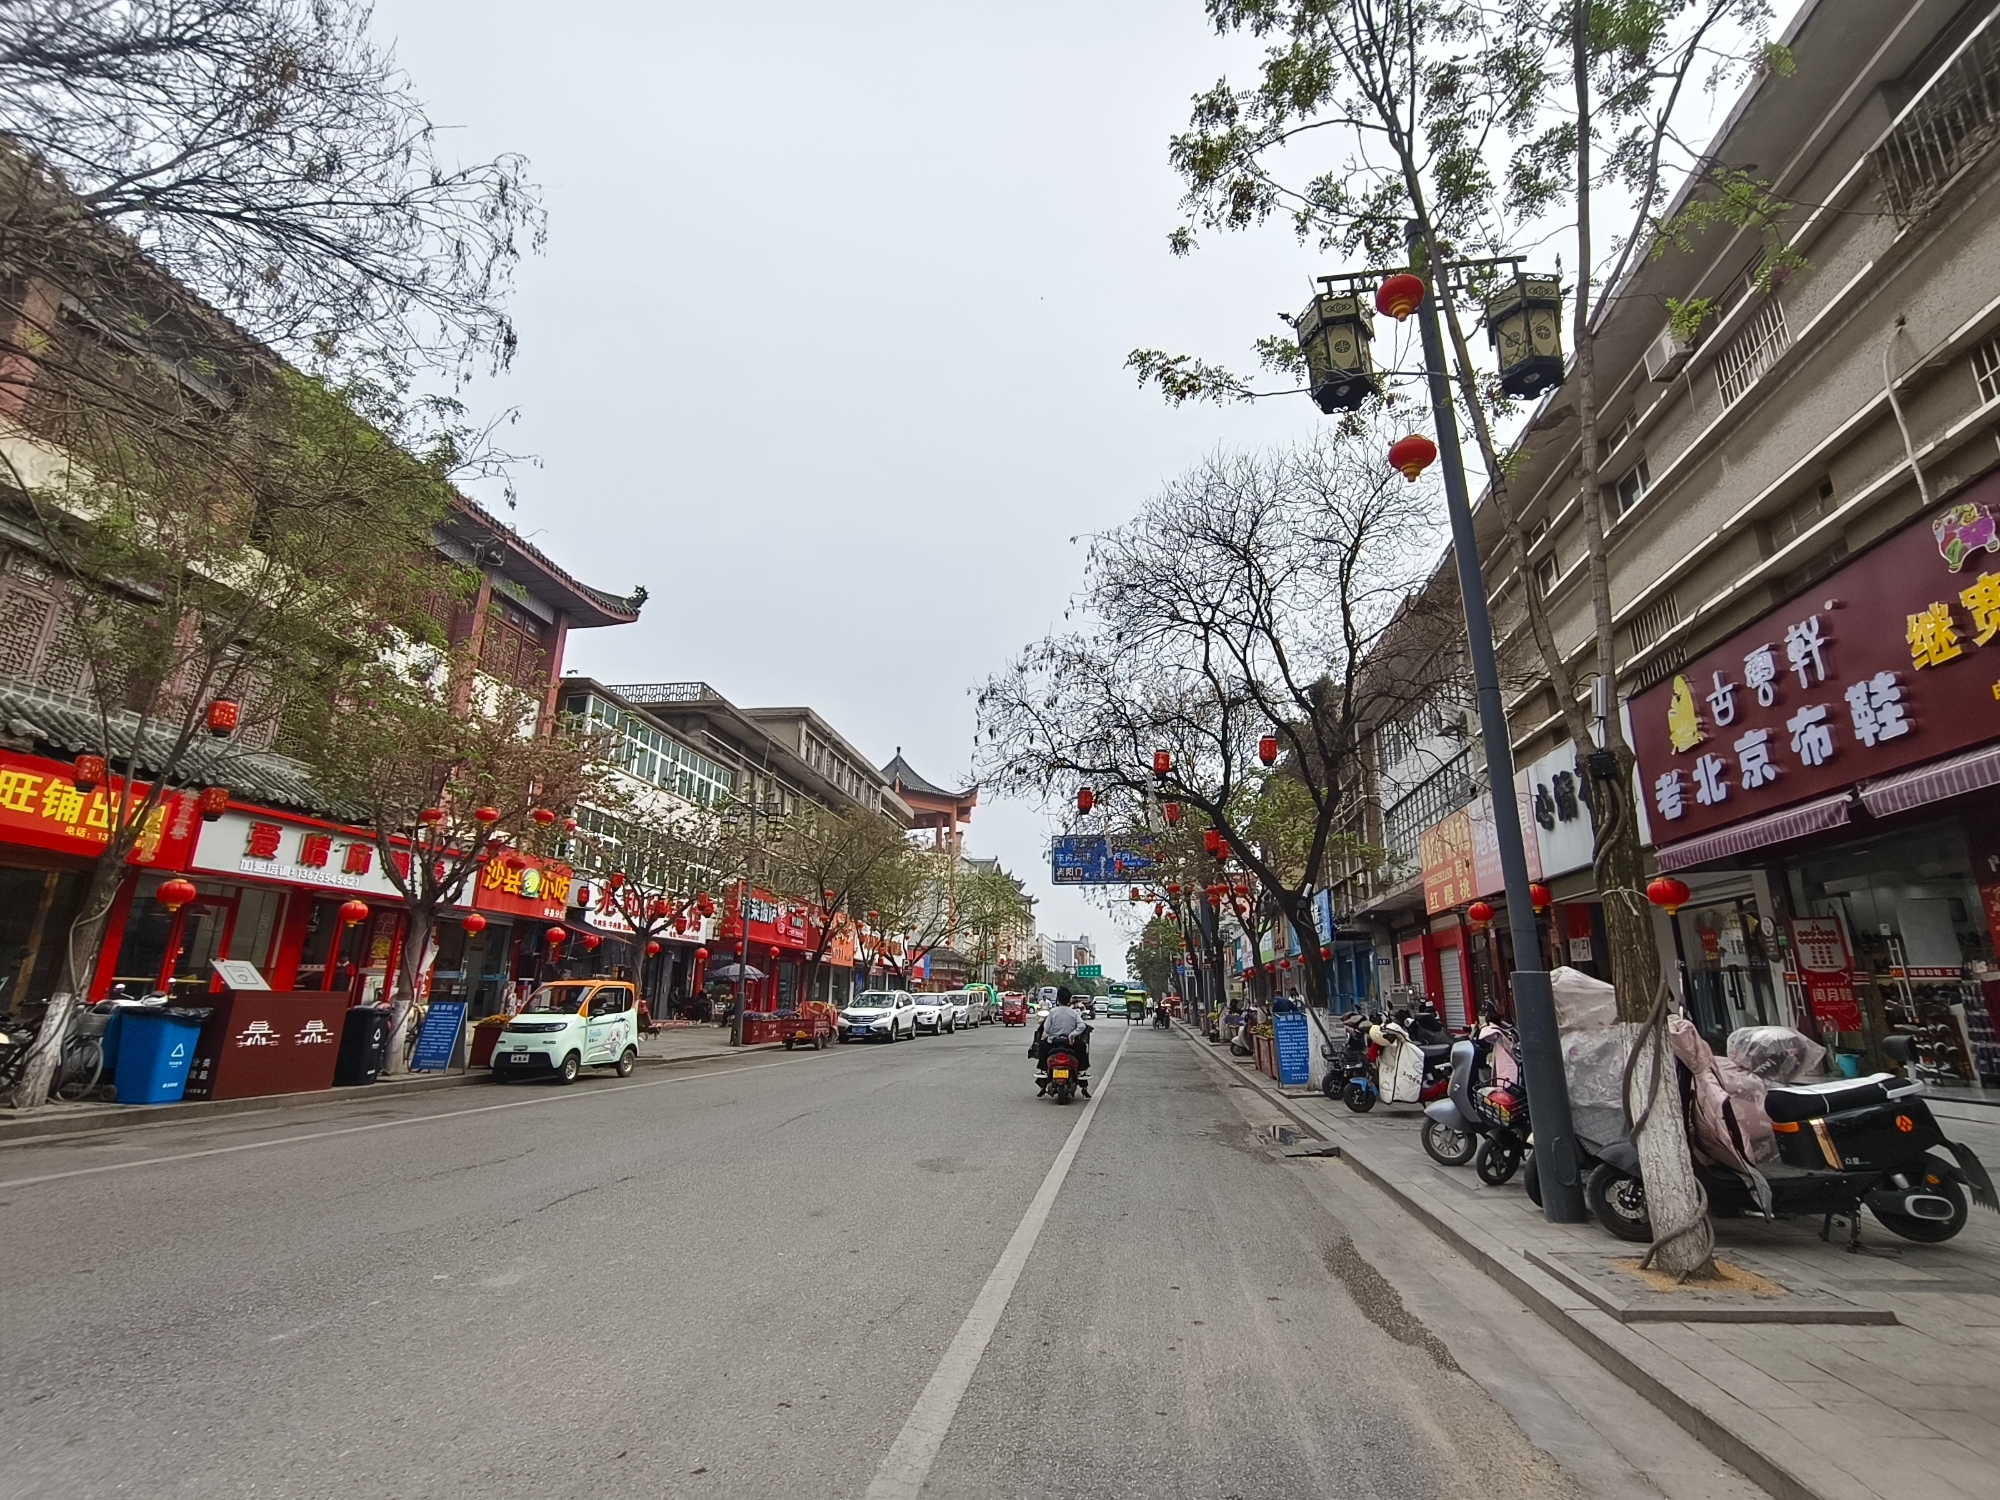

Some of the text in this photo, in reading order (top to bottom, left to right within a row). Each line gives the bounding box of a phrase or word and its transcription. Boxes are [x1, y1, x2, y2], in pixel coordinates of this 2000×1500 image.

[1655, 671, 1909, 821] 老北京布鞋
[483, 859, 571, 904] 沙县小吃
